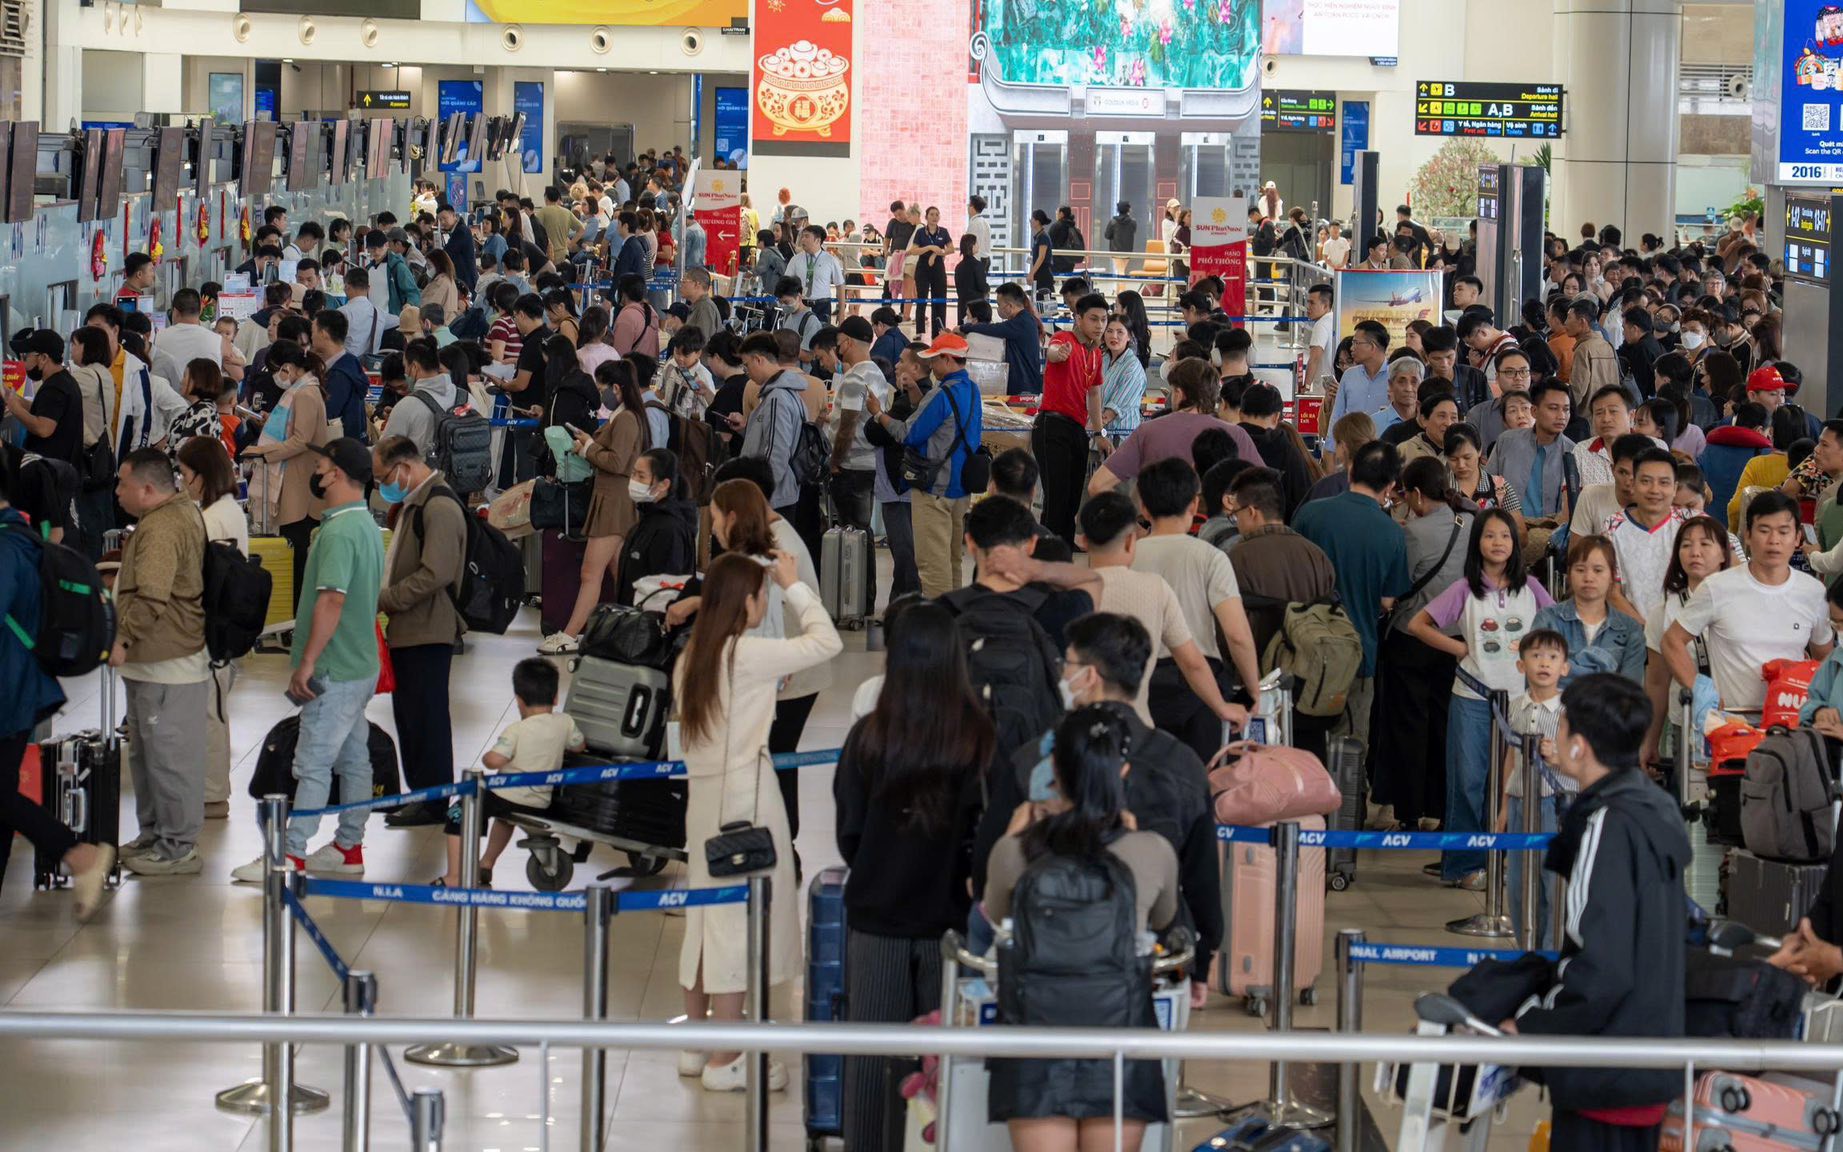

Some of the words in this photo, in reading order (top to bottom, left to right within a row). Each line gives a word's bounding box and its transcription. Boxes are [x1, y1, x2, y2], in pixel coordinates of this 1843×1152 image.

[1444, 84, 1455, 96] B
[1487, 103, 1513, 117] A,B
[1805, 147, 1819, 155] Scan
[1832, 148, 1841, 156] QR
[1792, 165, 1822, 178] 2016
[601, 767, 619, 779] ACV
[656, 763, 673, 773] ACV
[488, 776, 506, 787] ACV
[546, 773, 564, 784] ACV
[1217, 827, 1236, 839] CV
[1298, 833, 1327, 845] ACV
[1382, 834, 1412, 847] ACV
[1467, 835, 1497, 848] ACV
[509, 892, 554, 908] KHÔNG
[659, 891, 688, 906] ACV
[1382, 948, 1438, 962] AIRPORT
